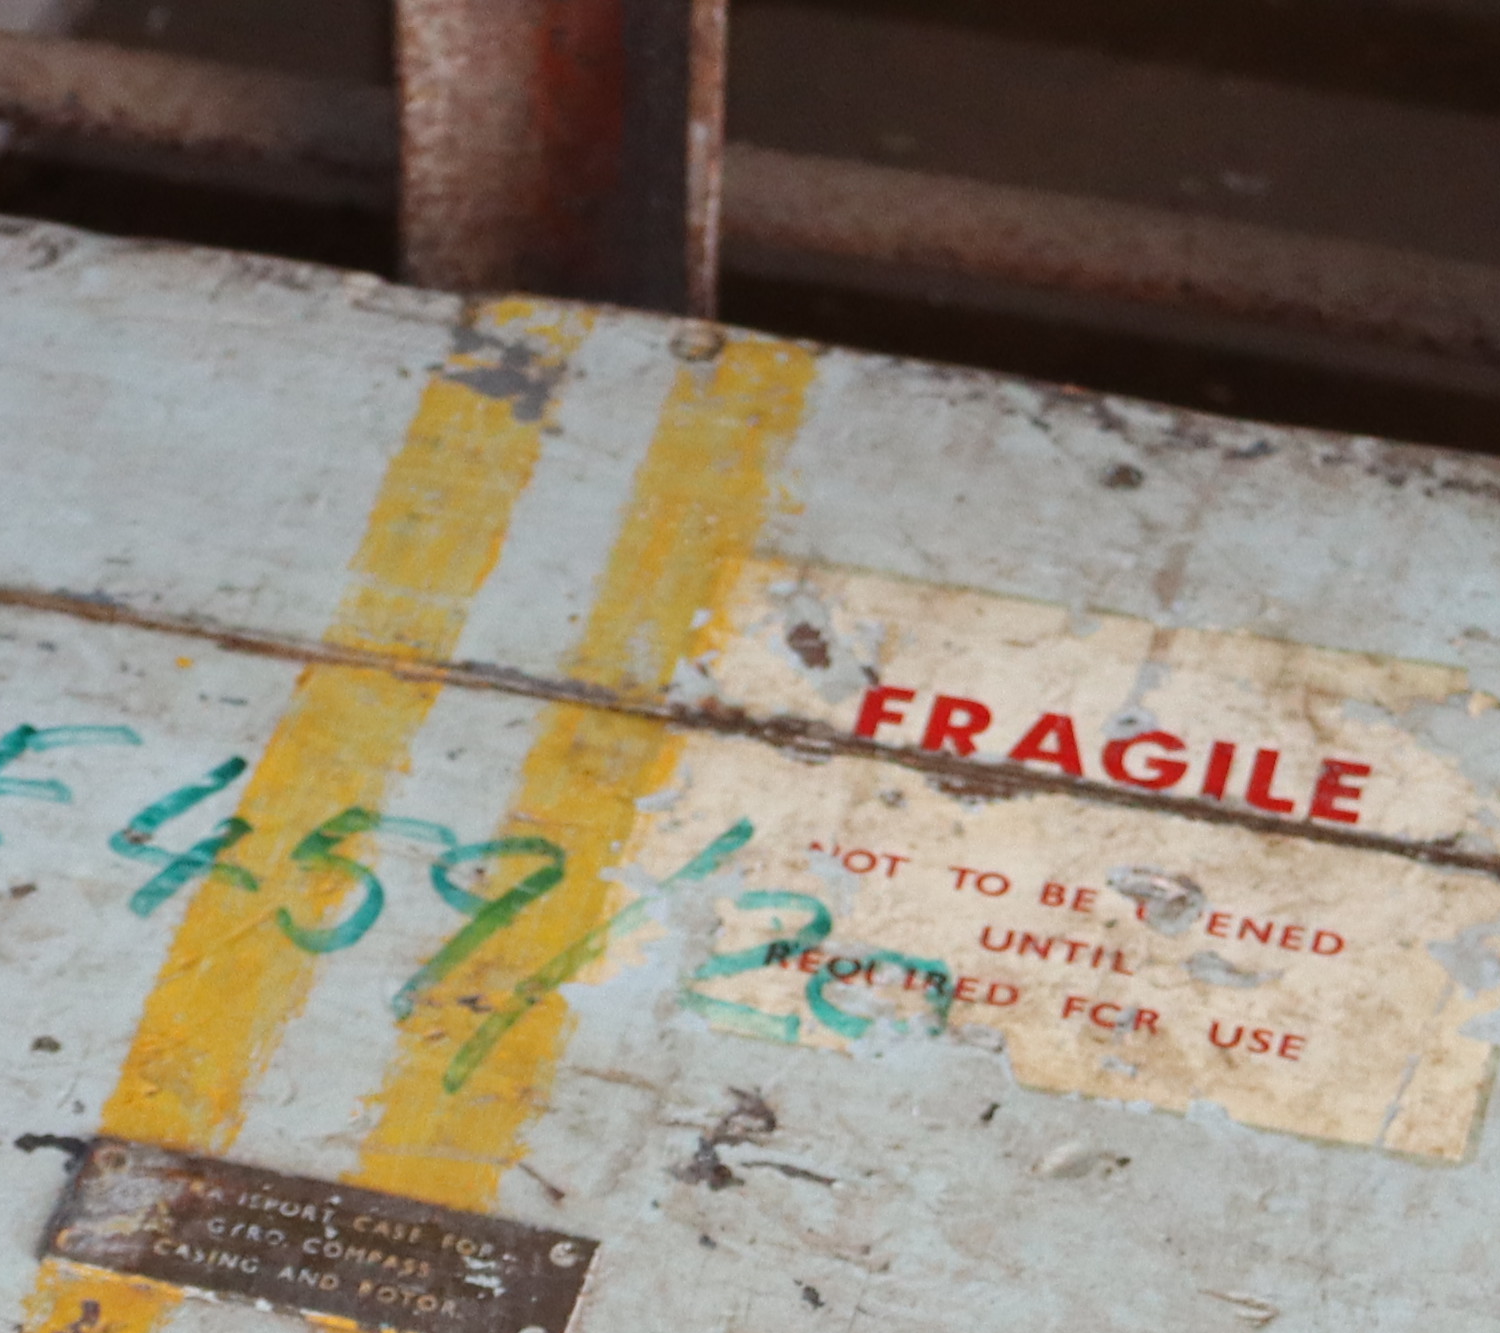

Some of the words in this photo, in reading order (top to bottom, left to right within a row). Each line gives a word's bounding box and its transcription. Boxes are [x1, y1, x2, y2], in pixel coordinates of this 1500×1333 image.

[854, 686, 1372, 825] FRAGILE
[948, 866, 1011, 896] TO
[1040, 881, 1098, 914] BE
[1136, 893, 1346, 956] ENED
[980, 926, 1134, 976] UNTIL
[1208, 1020, 1306, 1061] USE
[154, 1238, 259, 1274] CASING
[277, 1265, 340, 1291] AND
[358, 1279, 457, 1317] ROTOR
